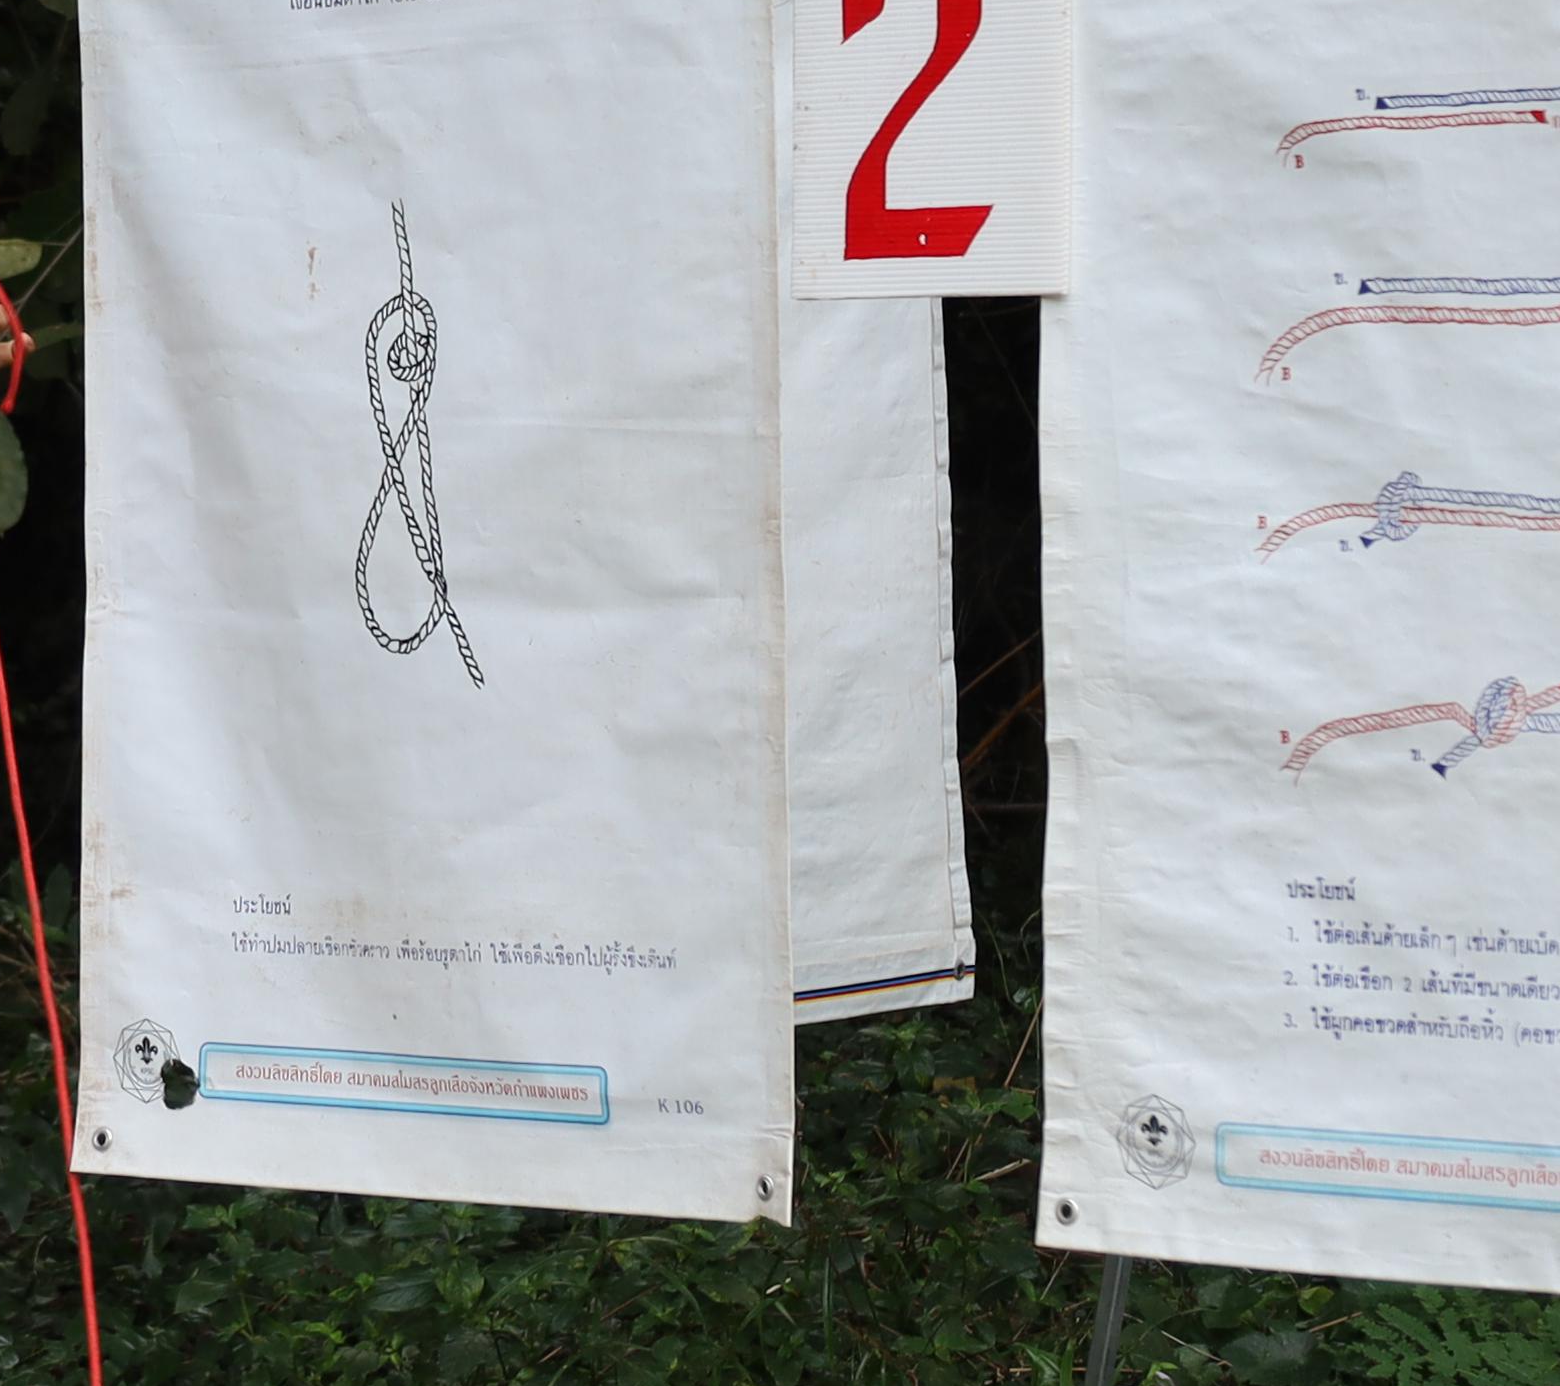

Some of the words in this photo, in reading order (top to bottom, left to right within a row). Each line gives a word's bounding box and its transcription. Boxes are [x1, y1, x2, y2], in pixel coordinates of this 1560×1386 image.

[1286, 876, 1356, 901] ประโยชน์
[232, 894, 292, 916] ประโยชน์
[675, 1100, 704, 1115] 106
